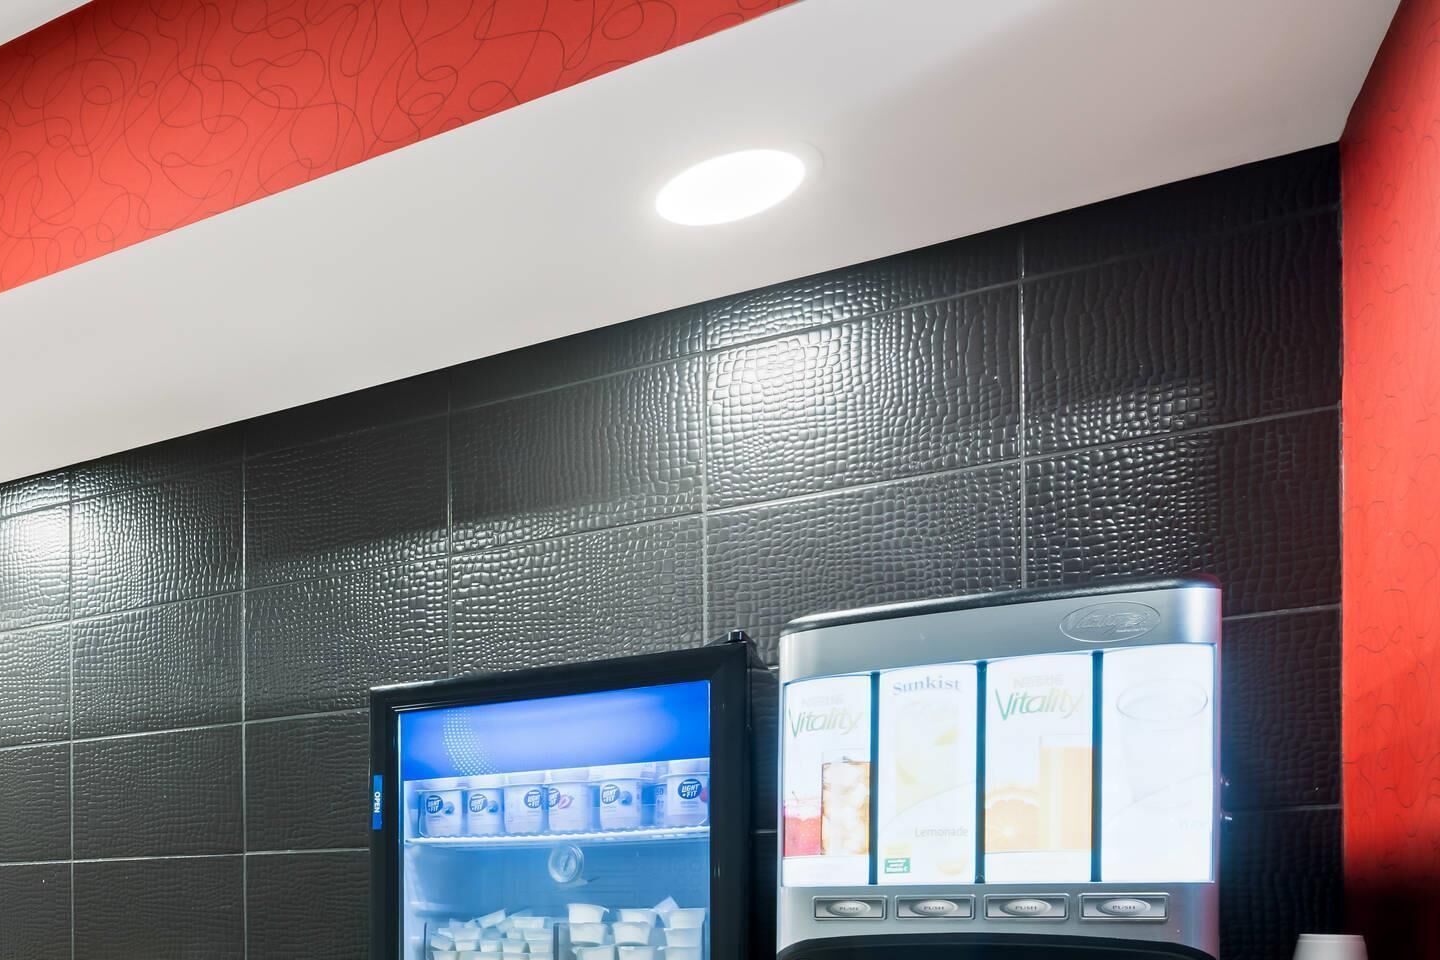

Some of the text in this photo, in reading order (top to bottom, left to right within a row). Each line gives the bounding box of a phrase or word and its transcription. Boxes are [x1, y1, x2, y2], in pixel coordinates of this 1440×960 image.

[893, 675, 962, 696] Sunkist
[995, 687, 1085, 721] Vitality
[788, 702, 864, 737] Vitality
[914, 825, 969, 838] Lemonade
